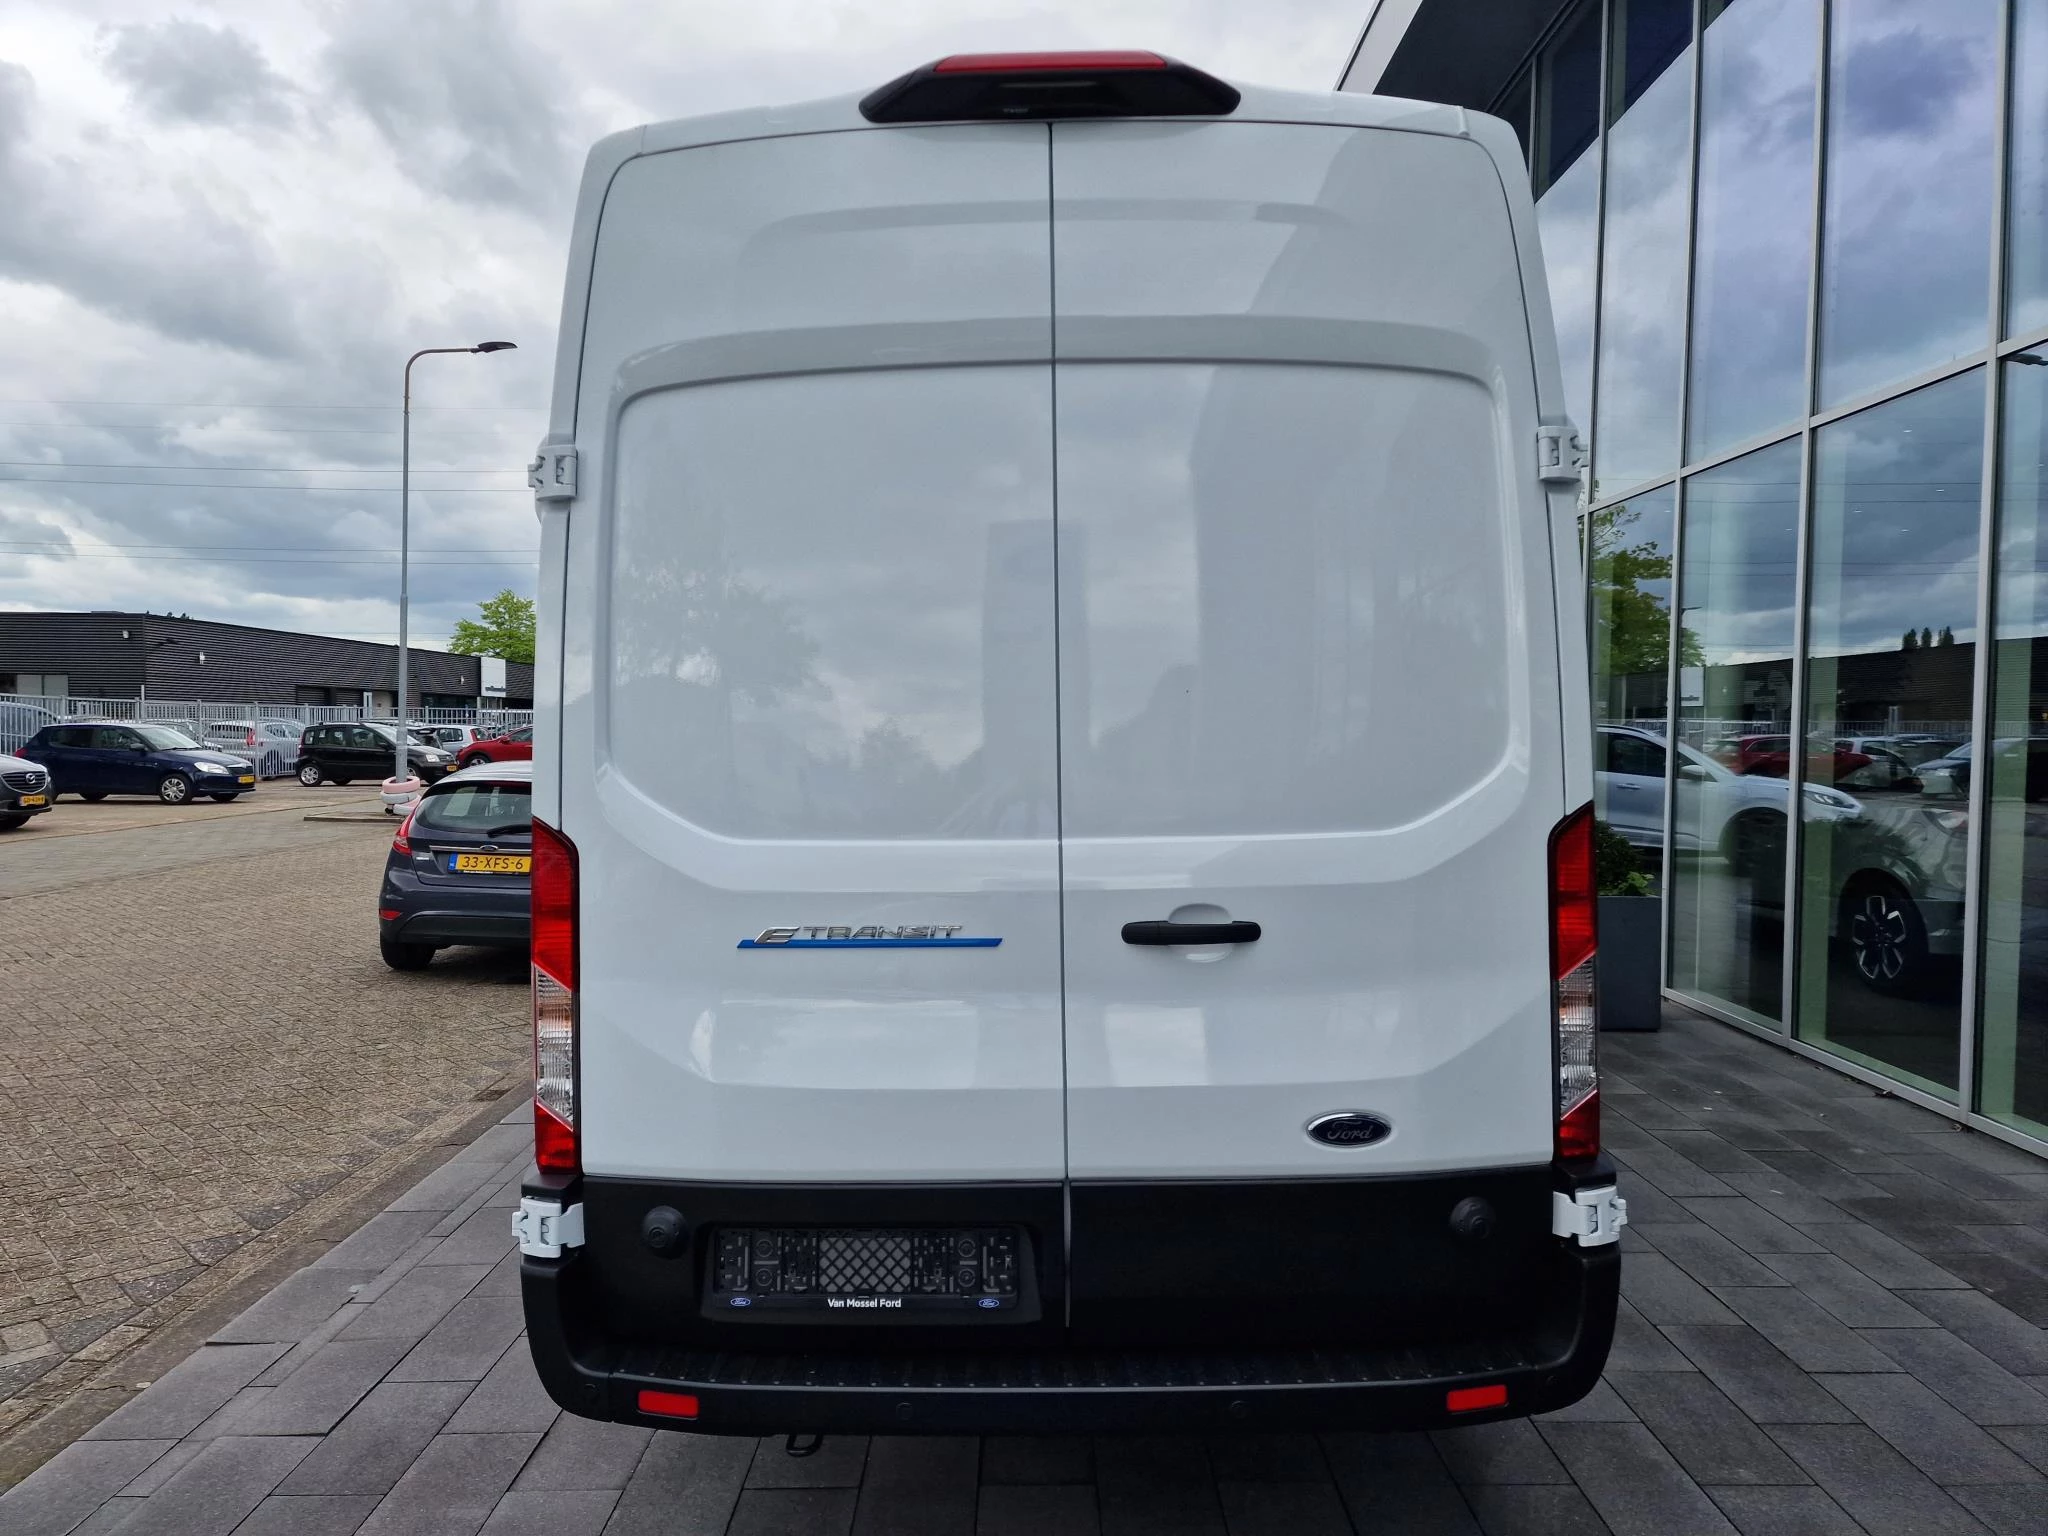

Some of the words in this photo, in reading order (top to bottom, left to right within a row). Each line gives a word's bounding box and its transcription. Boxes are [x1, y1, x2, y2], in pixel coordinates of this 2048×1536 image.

[462, 856, 523, 870] 33-XFS-6
[803, 925, 962, 940] TRANSIT
[1327, 1120, 1374, 1140] Ford
[828, 1298, 844, 1308] Van
[847, 1298, 877, 1308] Mossel
[880, 1298, 902, 1308] Ford
